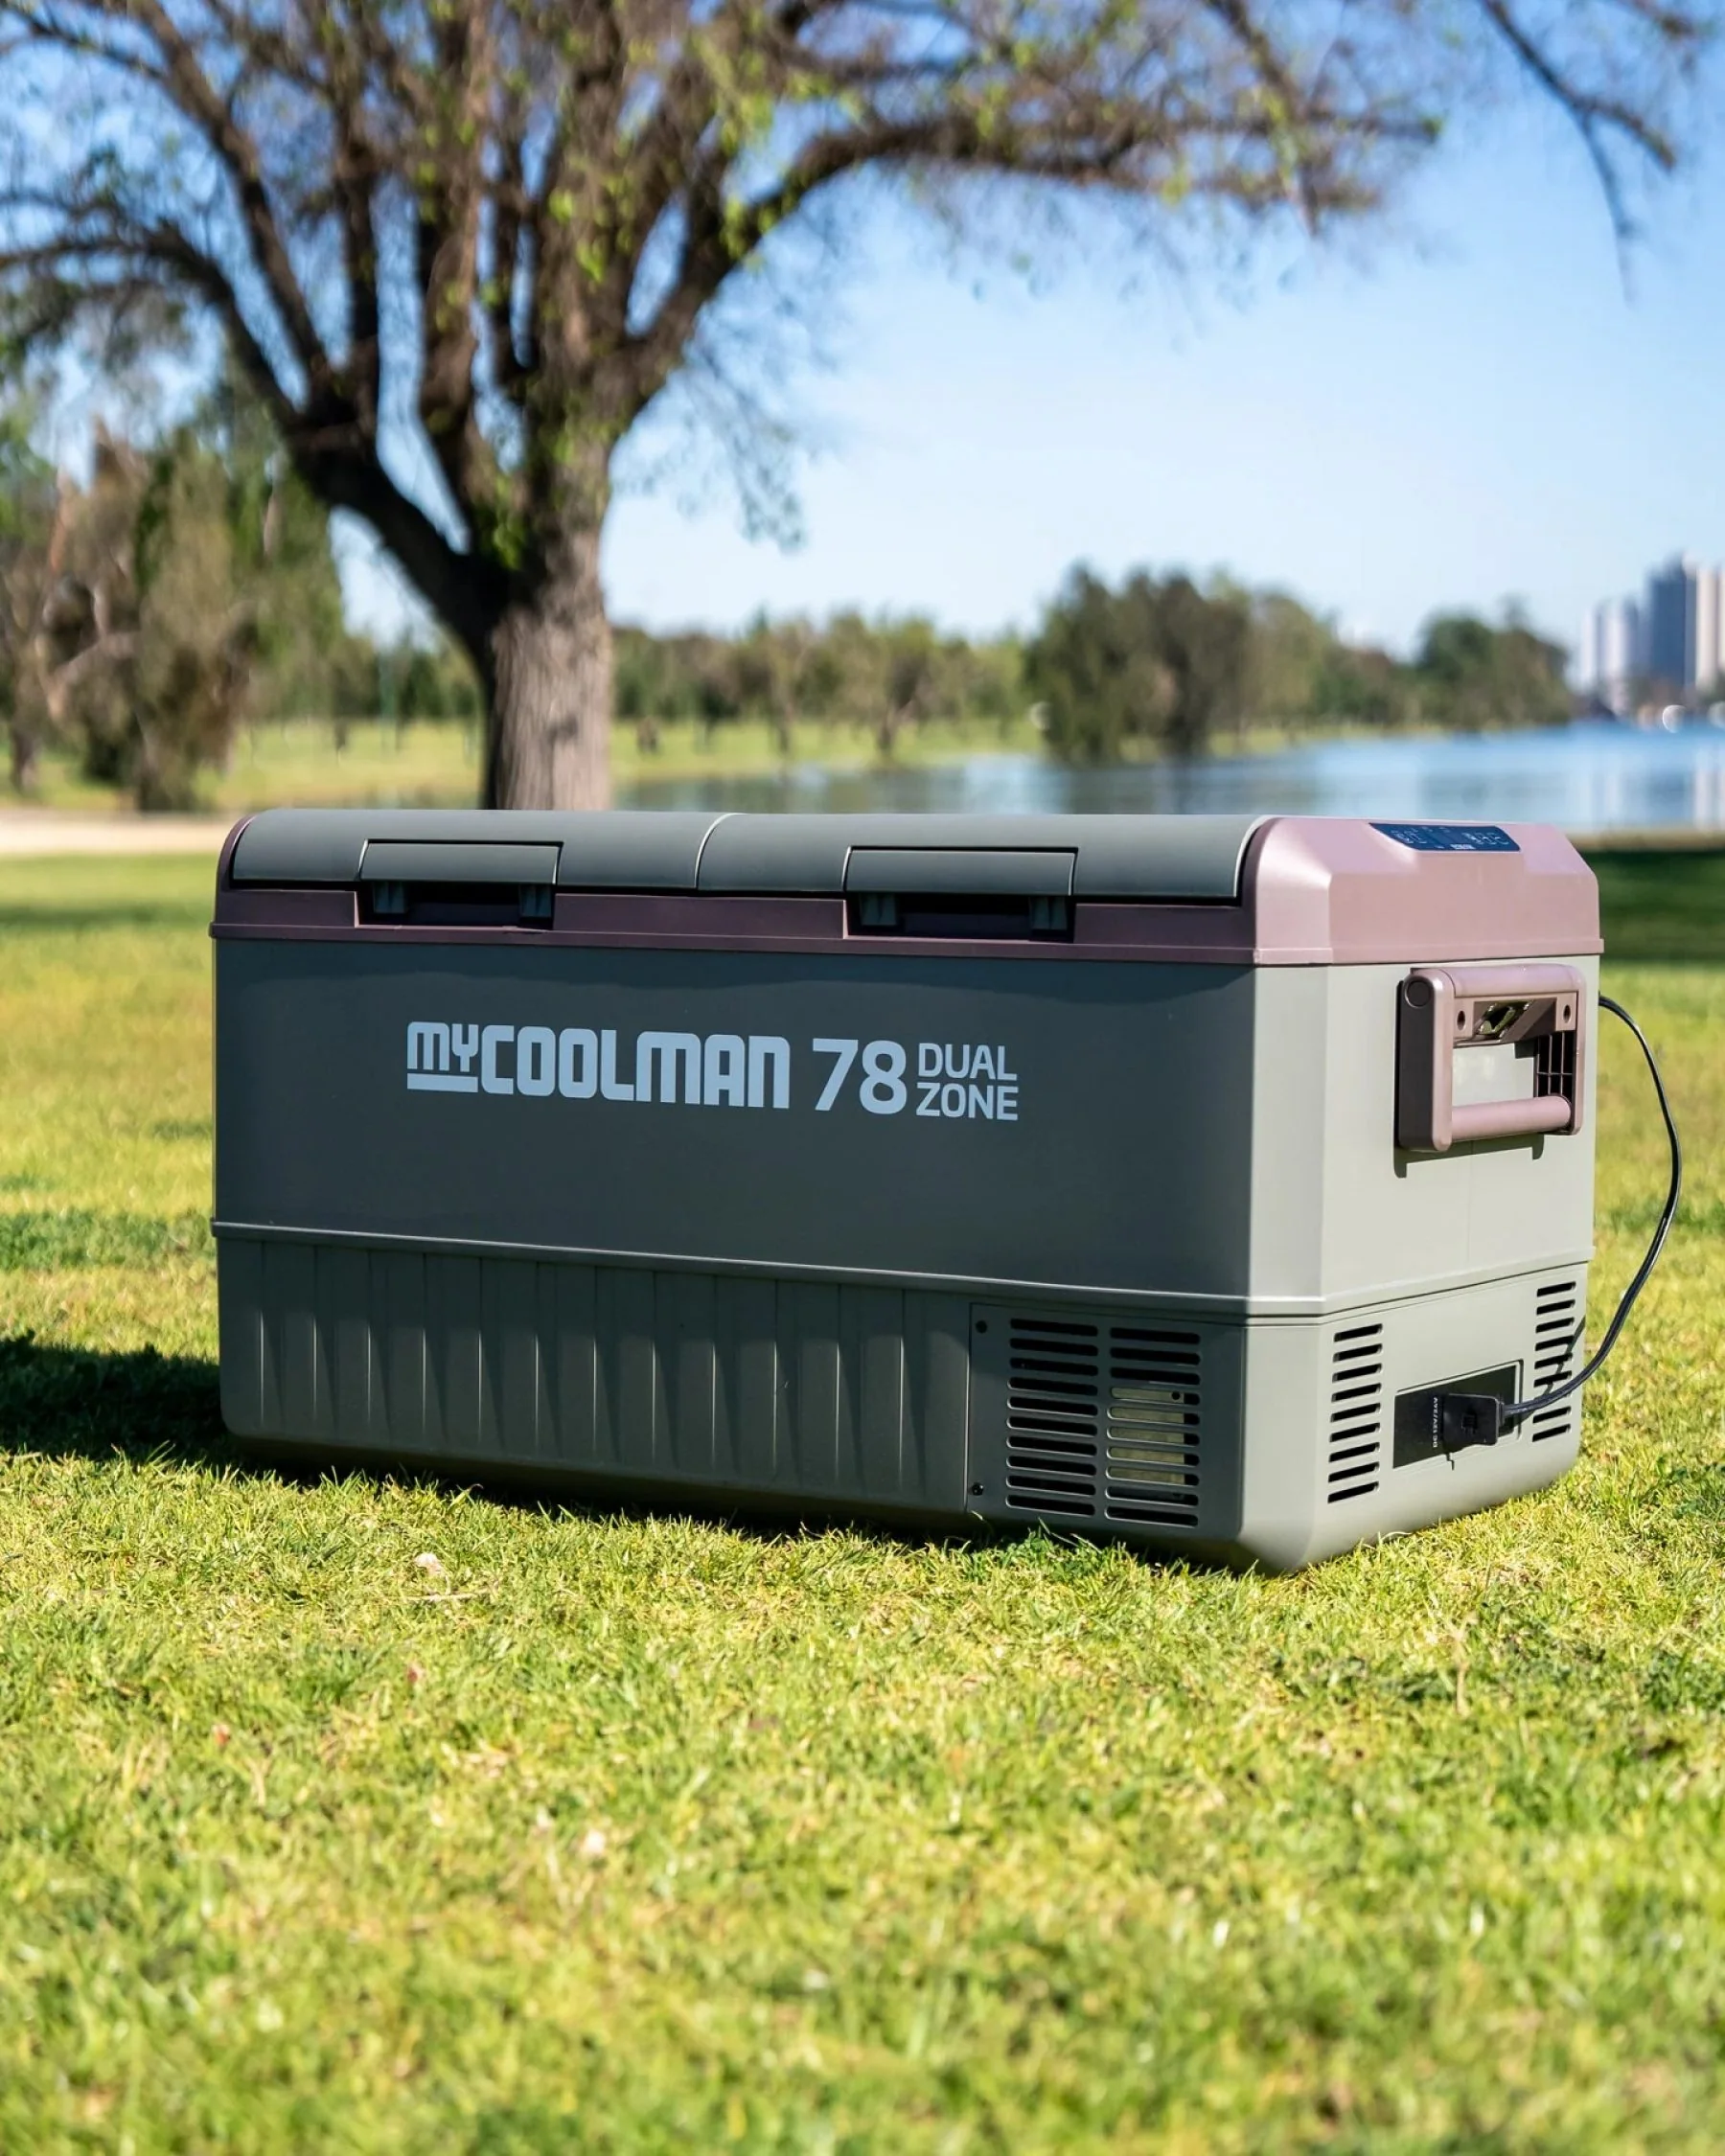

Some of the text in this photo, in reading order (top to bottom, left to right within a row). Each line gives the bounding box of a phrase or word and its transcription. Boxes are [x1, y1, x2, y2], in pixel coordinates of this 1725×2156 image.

[812, 1038, 908, 1115] 78
[917, 1042, 1018, 1081] DUAL
[915, 1082, 1019, 1121] ZONE
